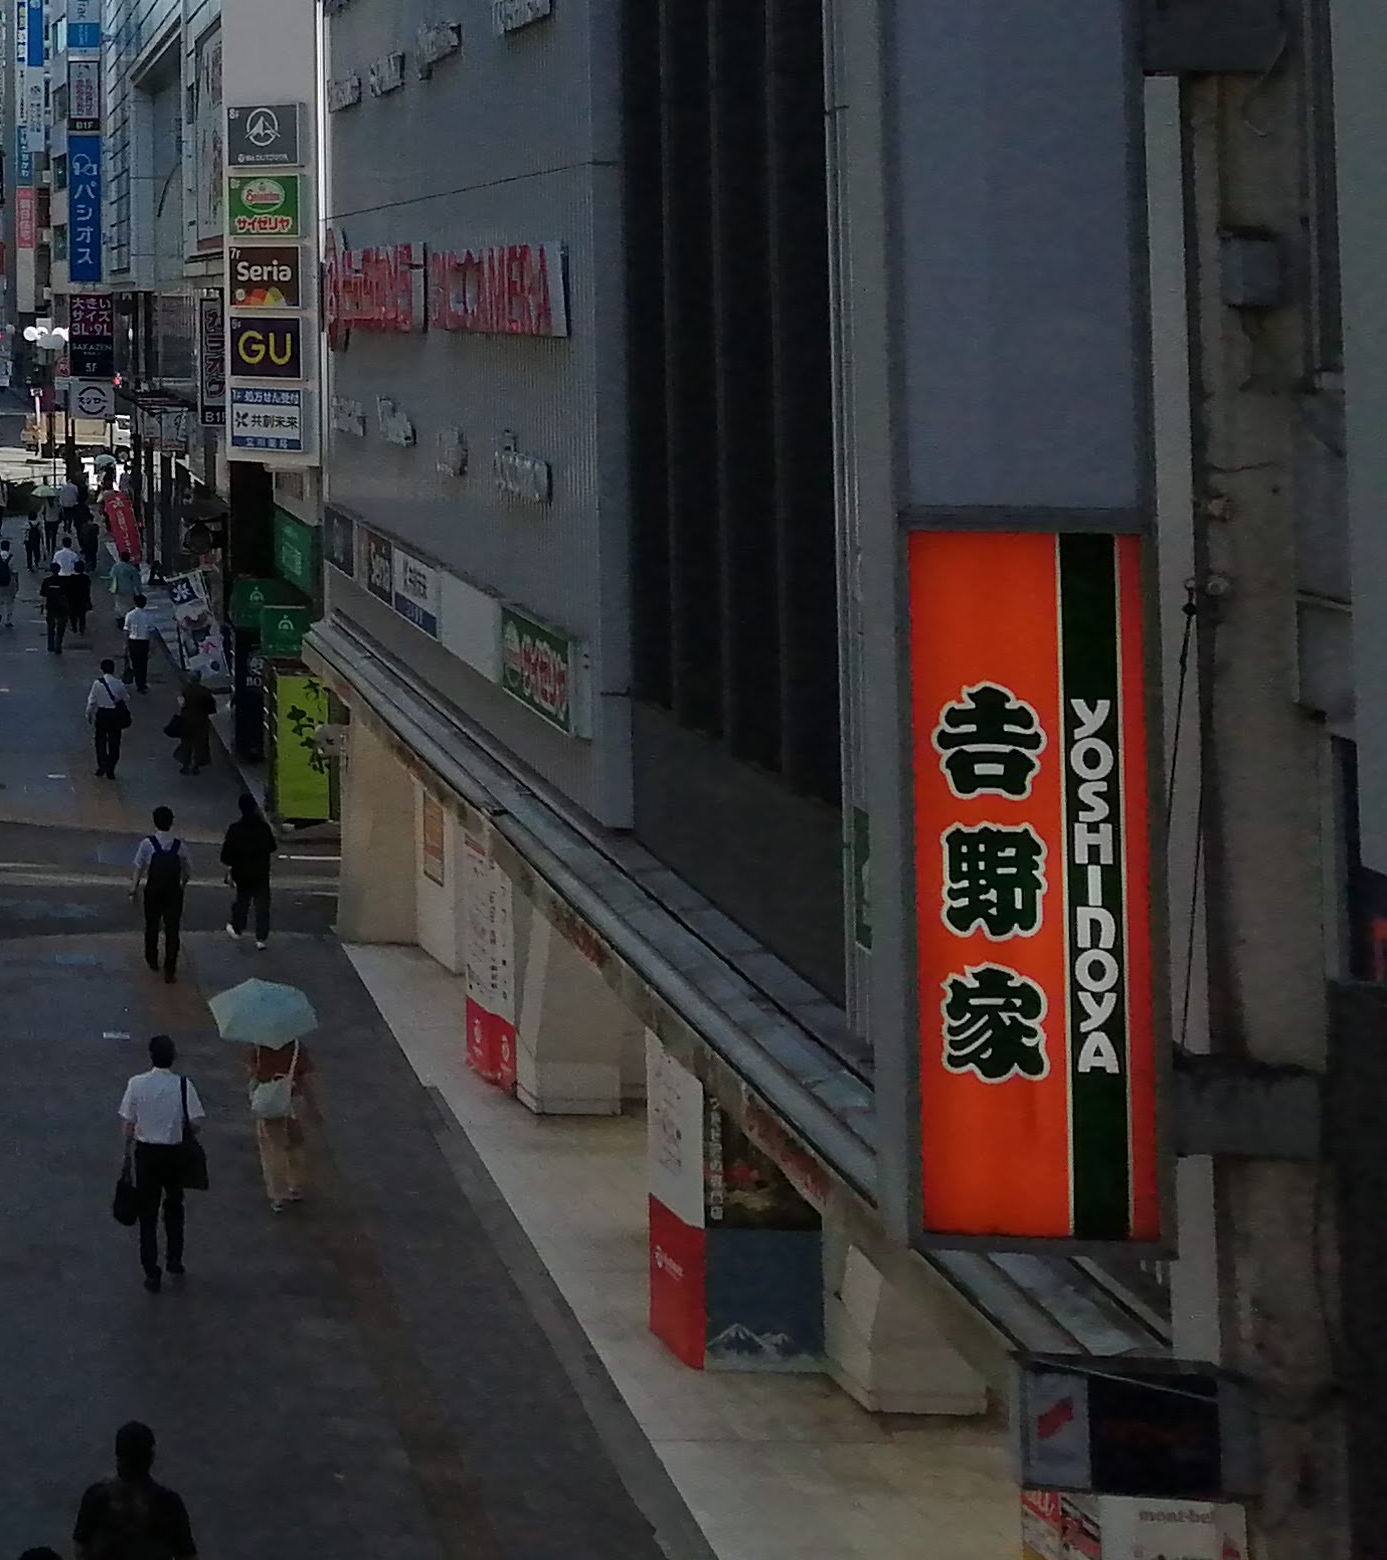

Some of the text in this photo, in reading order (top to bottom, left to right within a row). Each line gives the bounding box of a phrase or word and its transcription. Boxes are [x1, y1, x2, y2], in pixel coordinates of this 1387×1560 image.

[73, 180, 97, 265] パシオス
[236, 216, 291, 232] サイゼリヤ
[237, 260, 292, 283] Seria
[72, 297, 112, 310] 大きい
[72, 310, 111, 323] サイズ
[238, 330, 293, 366] GU
[77, 395, 109, 405] スシロー
[251, 414, 299, 429] 共創未来
[932, 680, 1051, 1084] 吉野家
[1068, 696, 1120, 1076] YOSHINOYA
